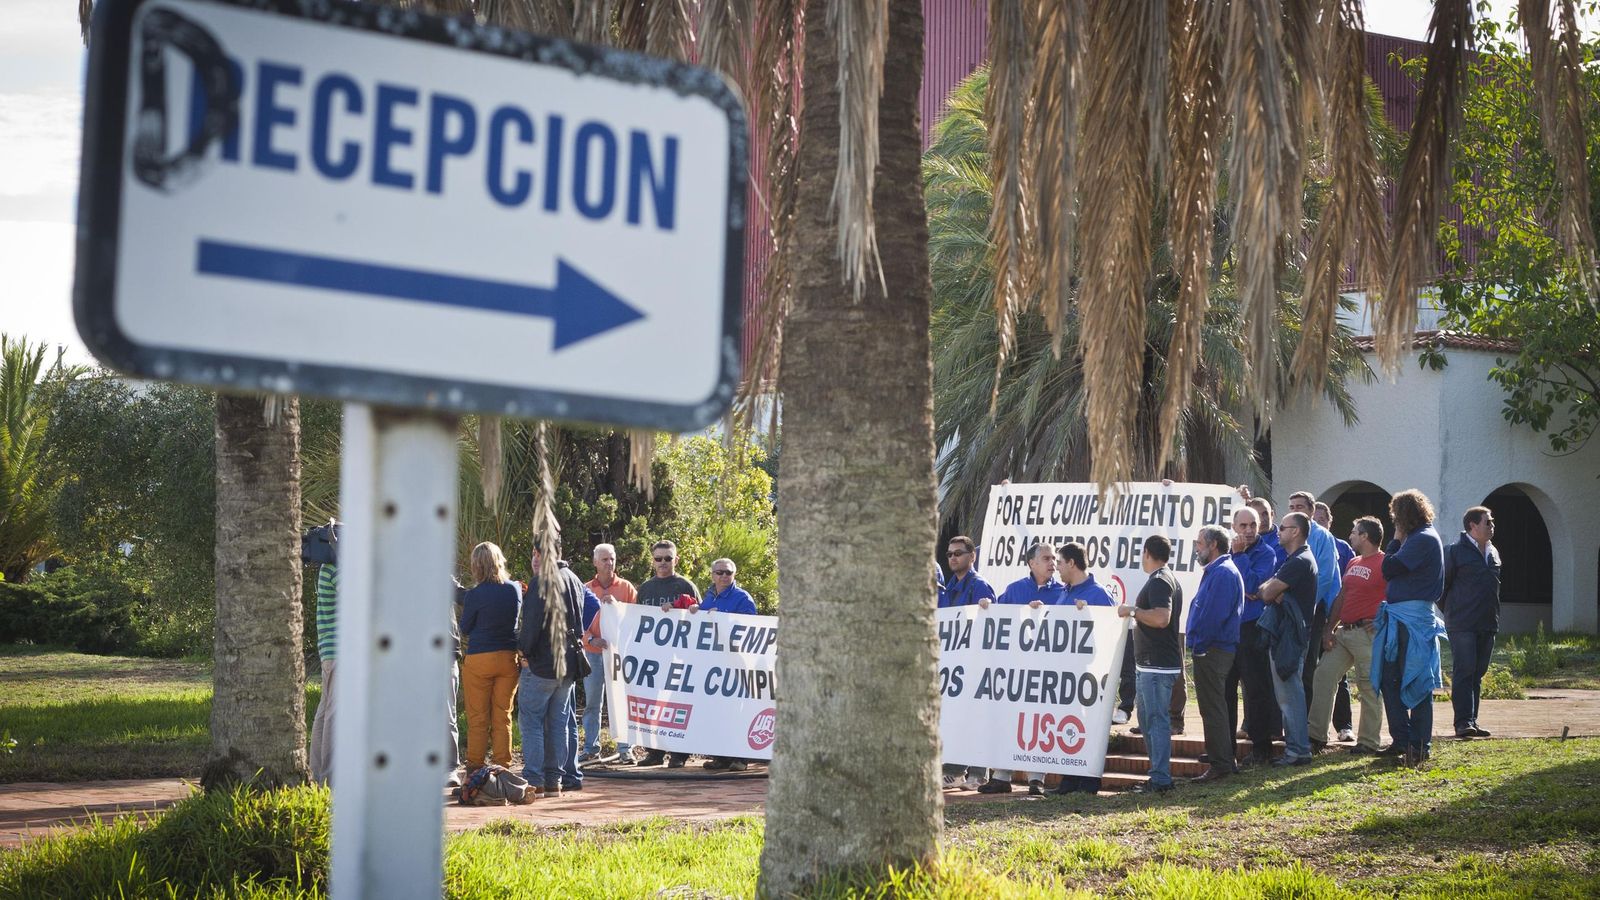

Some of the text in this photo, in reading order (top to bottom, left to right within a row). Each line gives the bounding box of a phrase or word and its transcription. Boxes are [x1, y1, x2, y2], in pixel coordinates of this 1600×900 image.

[995, 494, 1232, 529] POR EL CUMPLIMIENTO DE
[988, 535, 1015, 567] LOS
[1116, 536, 1142, 569] DE
[634, 615, 692, 649] POR
[696, 621, 724, 652] EL
[729, 624, 777, 655] EMP
[982, 617, 1012, 650] DE
[1019, 611, 1094, 654] CÁDIZ
[613, 653, 660, 688] POR
[664, 662, 695, 693] EL
[629, 701, 675, 723] CCOO
[1017, 712, 1086, 755] USO
[1032, 755, 1059, 765] SINDICAL
[1061, 758, 1087, 767] OBRERA
